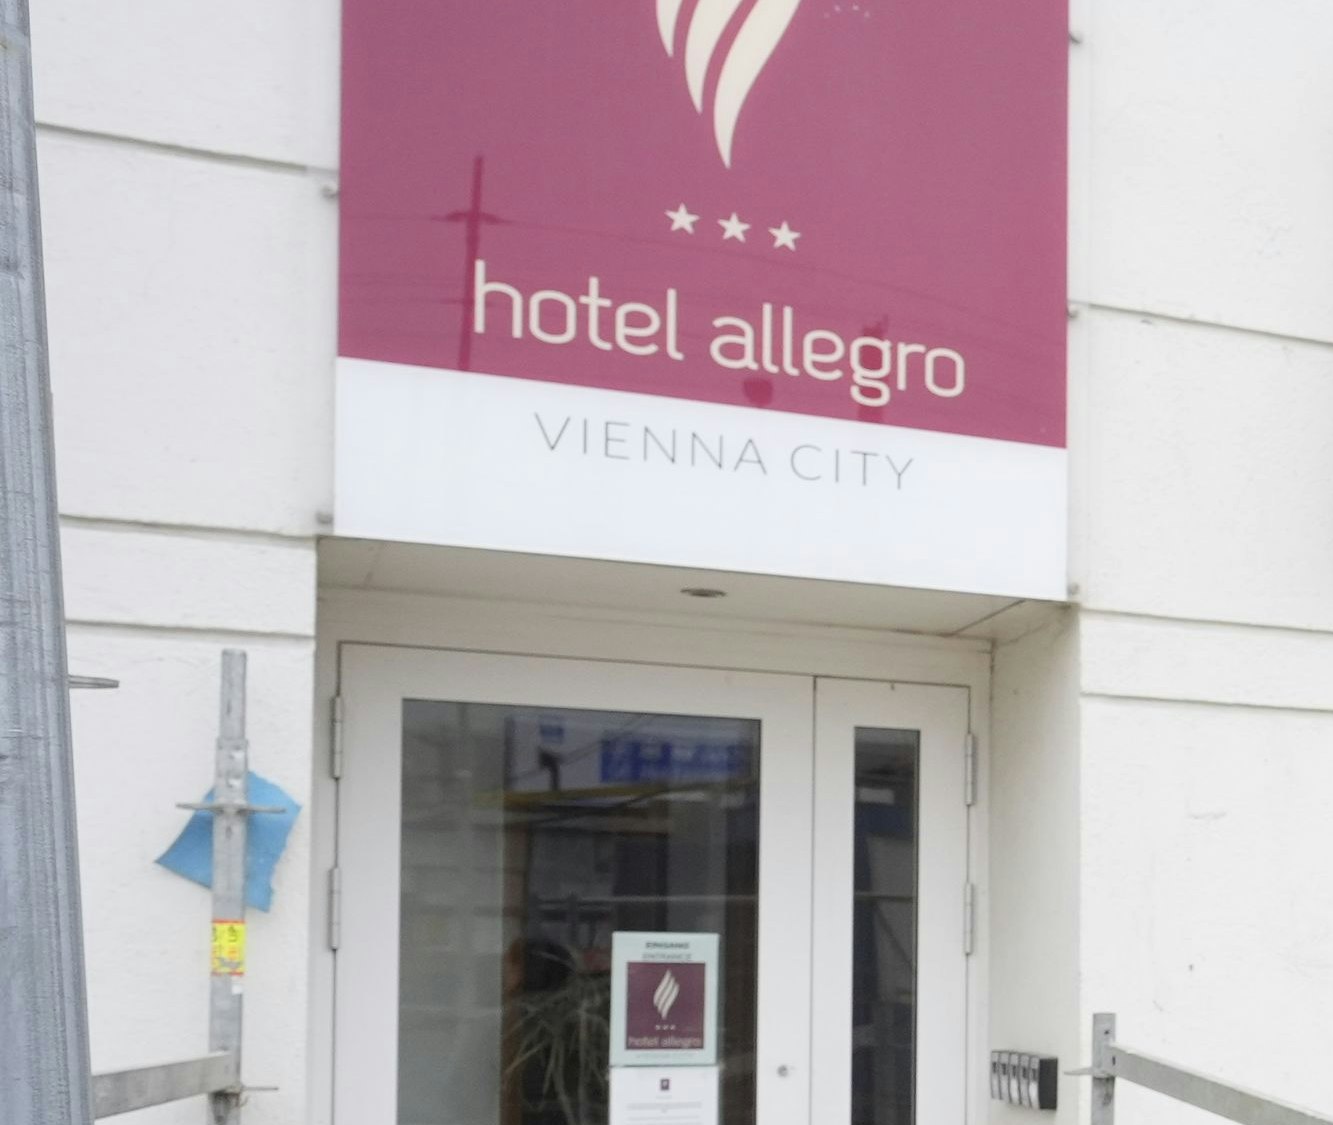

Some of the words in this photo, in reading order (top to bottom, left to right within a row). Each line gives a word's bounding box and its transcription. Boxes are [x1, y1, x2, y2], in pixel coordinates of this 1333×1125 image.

[473, 260, 683, 361] hotel
[711, 302, 965, 407] allegro
[533, 411, 768, 476] VIENNA
[790, 443, 917, 491] CITY
